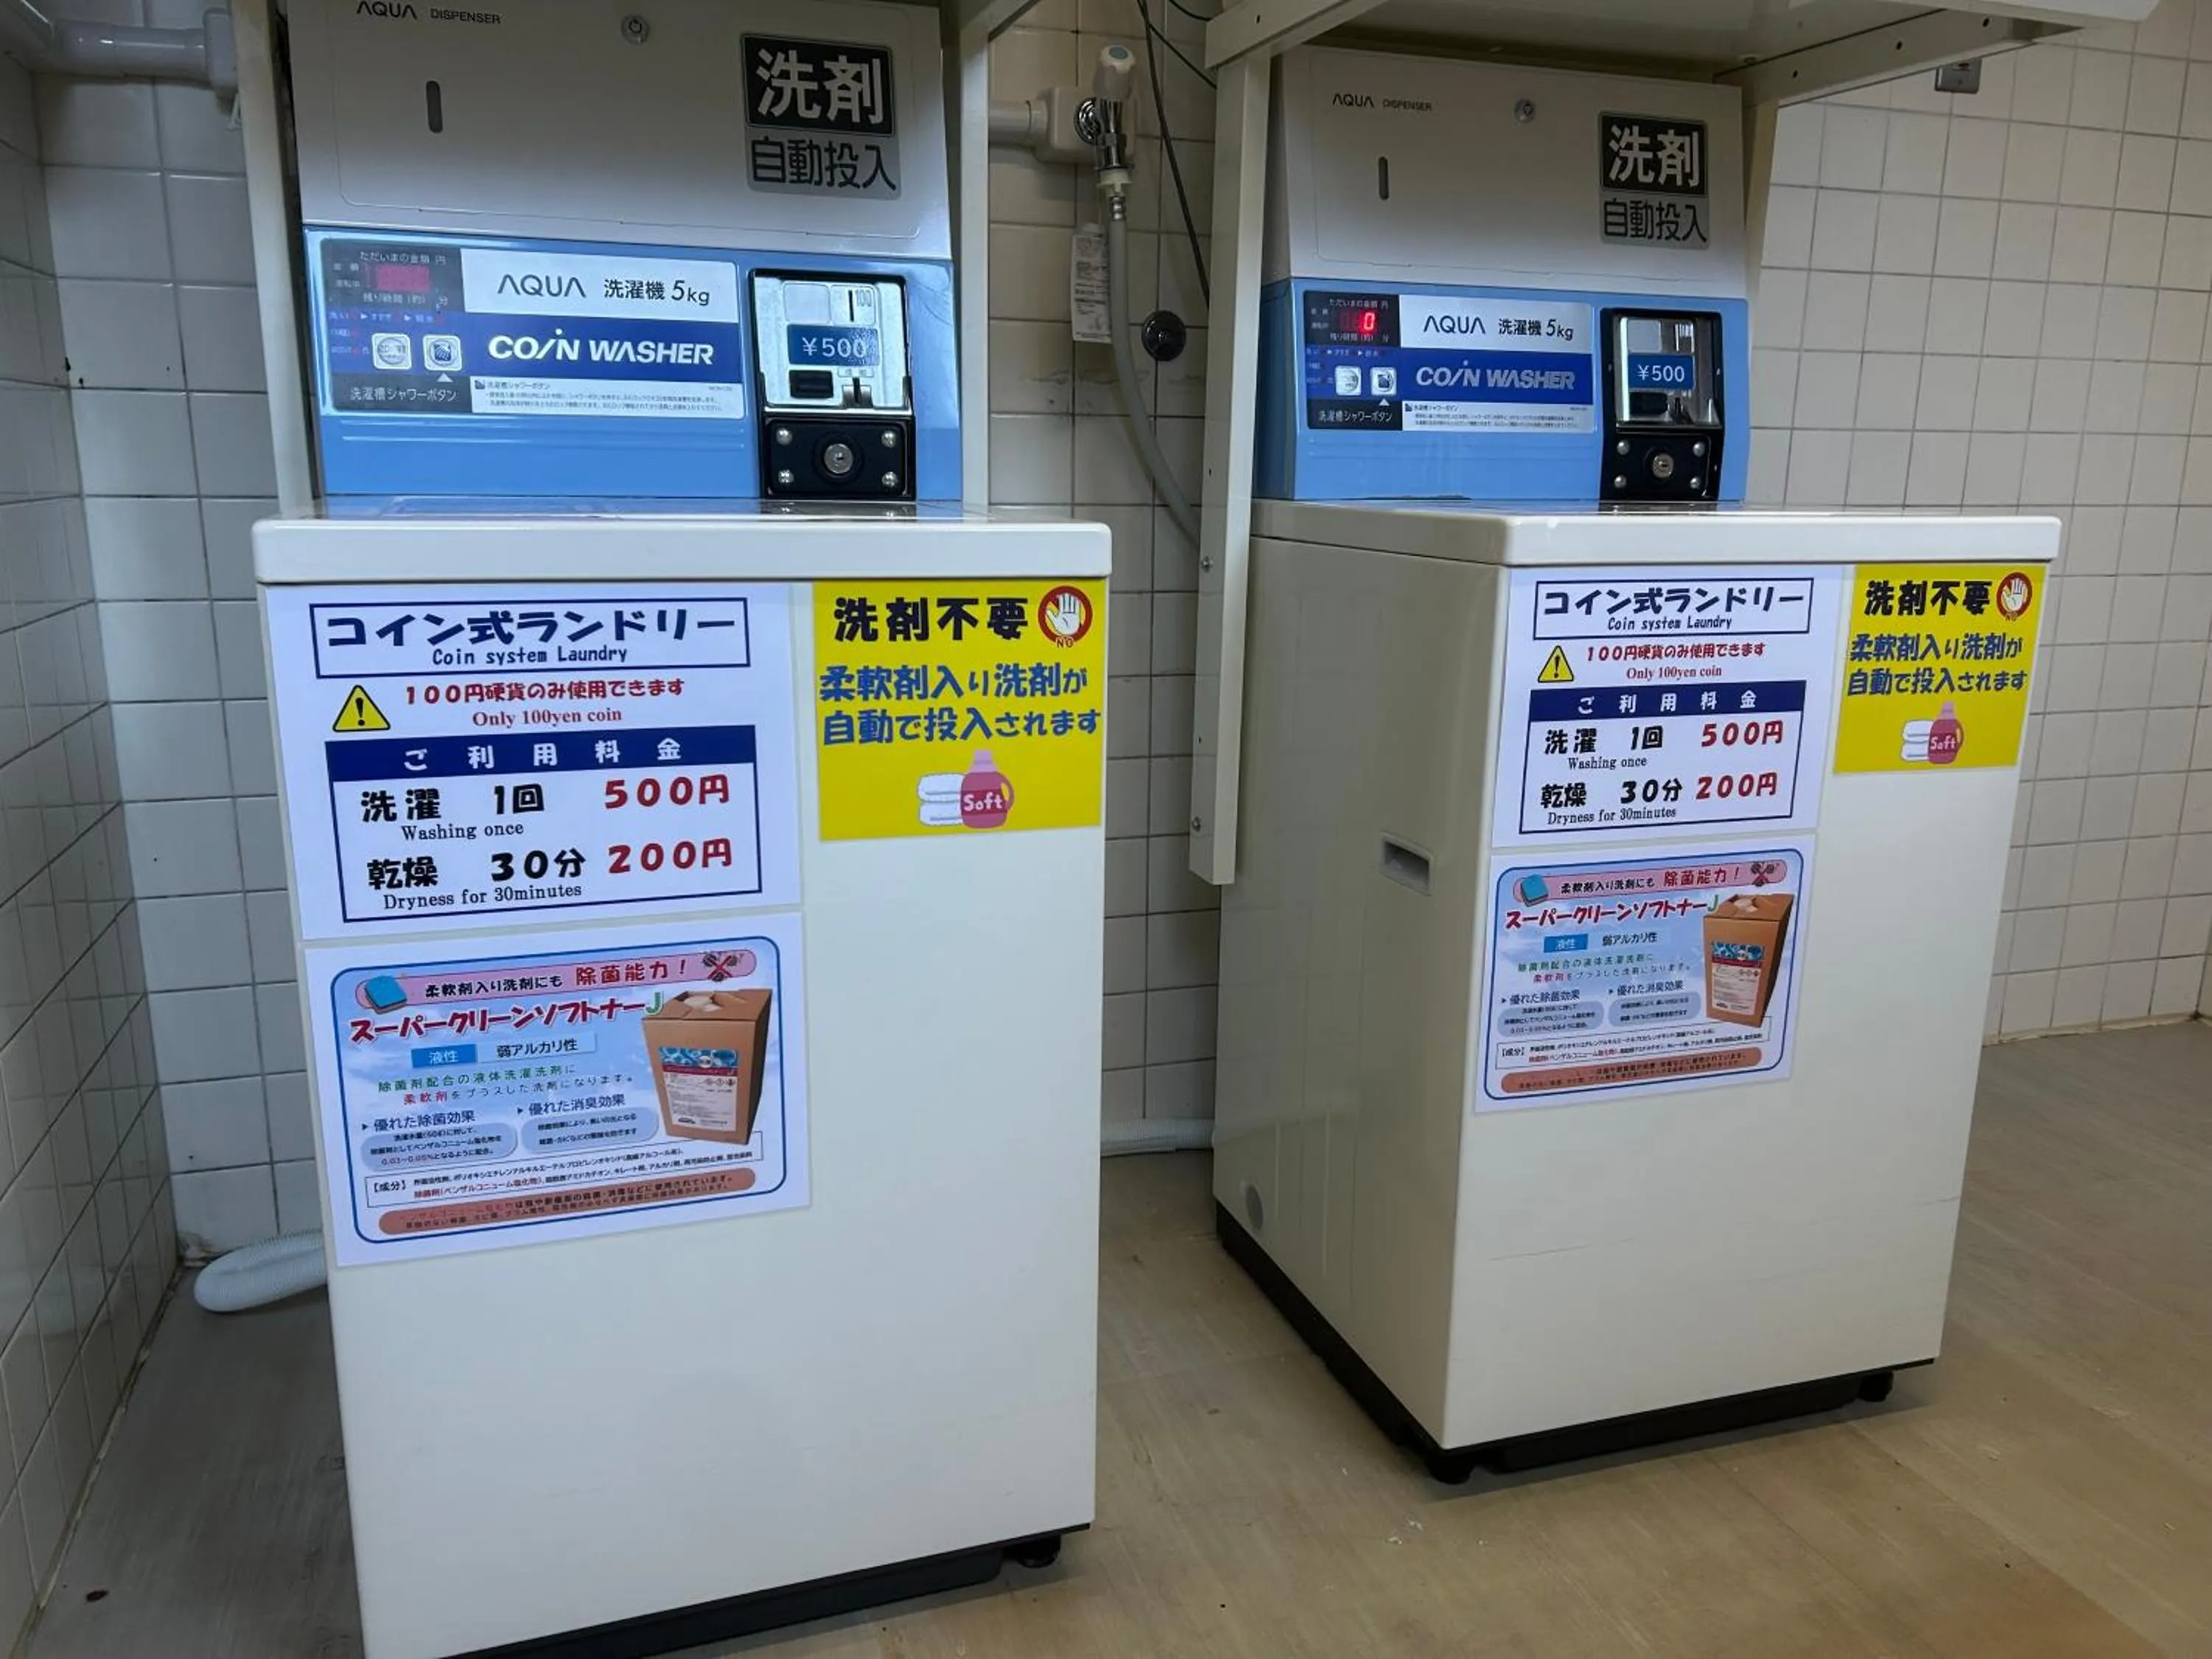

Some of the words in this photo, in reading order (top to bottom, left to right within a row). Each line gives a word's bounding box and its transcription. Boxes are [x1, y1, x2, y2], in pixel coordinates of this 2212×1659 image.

[356, 1, 418, 20] AQUA
[431, 8, 501, 24] DISPENSER
[755, 48, 884, 125] 洗剤
[1332, 94, 1374, 108] AQUA
[1382, 99, 1432, 111] DISPENSER
[752, 136, 897, 191] 自動投入
[1608, 125, 1700, 188] 洗剤
[1604, 198, 1707, 243] 自動投入
[498, 274, 586, 299] AQUA
[603, 278, 665, 301] 洗濯機
[671, 280, 710, 306] 5kg
[1364, 312, 1375, 330] 0
[1423, 315, 1486, 335] AQUA
[1498, 318, 1542, 336] 洗濯機
[1545, 319, 1574, 341] 5kg
[589, 340, 714, 364] WASHER
[802, 337, 866, 358] ¥500
[1486, 369, 1575, 390] WASHER
[1637, 364, 1685, 382] ¥500
[349, 387, 456, 401] 洗濯槽シャワーボタン
[1545, 587, 1804, 616] コイン式ランドリー
[1864, 580, 1992, 616] 洗剤不要
[327, 609, 735, 647] コイン式ランドリー
[834, 597, 1029, 642] 洗剤不要
[1607, 617, 1635, 630] Coin
[1641, 617, 1681, 630] system
[1686, 615, 1732, 630] Laundry
[433, 649, 474, 666] Coin
[486, 646, 547, 665] system
[557, 645, 627, 663] Laundry
[1055, 637, 1074, 648] NO
[1850, 632, 2023, 662] 柔軟剤入り洗剤が
[820, 663, 1088, 702] 柔軟剤入り洗剤が
[1627, 667, 1654, 681] Only
[1658, 666, 1697, 681] 100yen
[1700, 665, 1722, 677] coin
[1847, 667, 2028, 696] 自動で投入されます
[406, 679, 684, 704] 100円硬貨のみ使用できます
[473, 710, 515, 728] Only
[522, 709, 582, 726] 100yen
[588, 708, 622, 723] coin
[824, 707, 1101, 745] 自動で投入されます
[1545, 727, 1598, 754] 洗濯
[1631, 725, 1663, 750] 1回
[1700, 720, 1784, 748] 500円
[1930, 735, 1956, 750] Soft
[1568, 757, 1617, 771] Washing
[1621, 757, 1647, 768] once
[361, 787, 441, 823] 洗濯
[494, 783, 545, 815] 1回
[605, 773, 730, 809] 500円
[964, 791, 1002, 812] Soft
[1540, 782, 1587, 809] 乾燥
[1621, 778, 1683, 804] 30分
[1696, 772, 1778, 801] 200円
[1548, 810, 1594, 825] Dryness
[1599, 809, 1616, 821] for
[1620, 807, 1677, 820] 30minutes
[401, 822, 477, 841] Washing
[484, 821, 524, 837] once
[366, 855, 438, 890] 乾燥
[490, 848, 586, 882] 30分
[608, 838, 732, 874] 200円
[383, 891, 454, 911] Dryness
[462, 888, 487, 904] for
[494, 884, 582, 902] 30minutes
[425, 975, 563, 998] 柔軟剤入り洗剤にも
[576, 959, 686, 986] 除菌能力！
[349, 992, 663, 1043] スーパークリーンソフトナーJ
[428, 1050, 459, 1065] 液性
[496, 1038, 578, 1060] 弱アルカリ性
[529, 1093, 625, 1116] 優れた消臭効果
[374, 1110, 476, 1132] 優れた除菌効果
